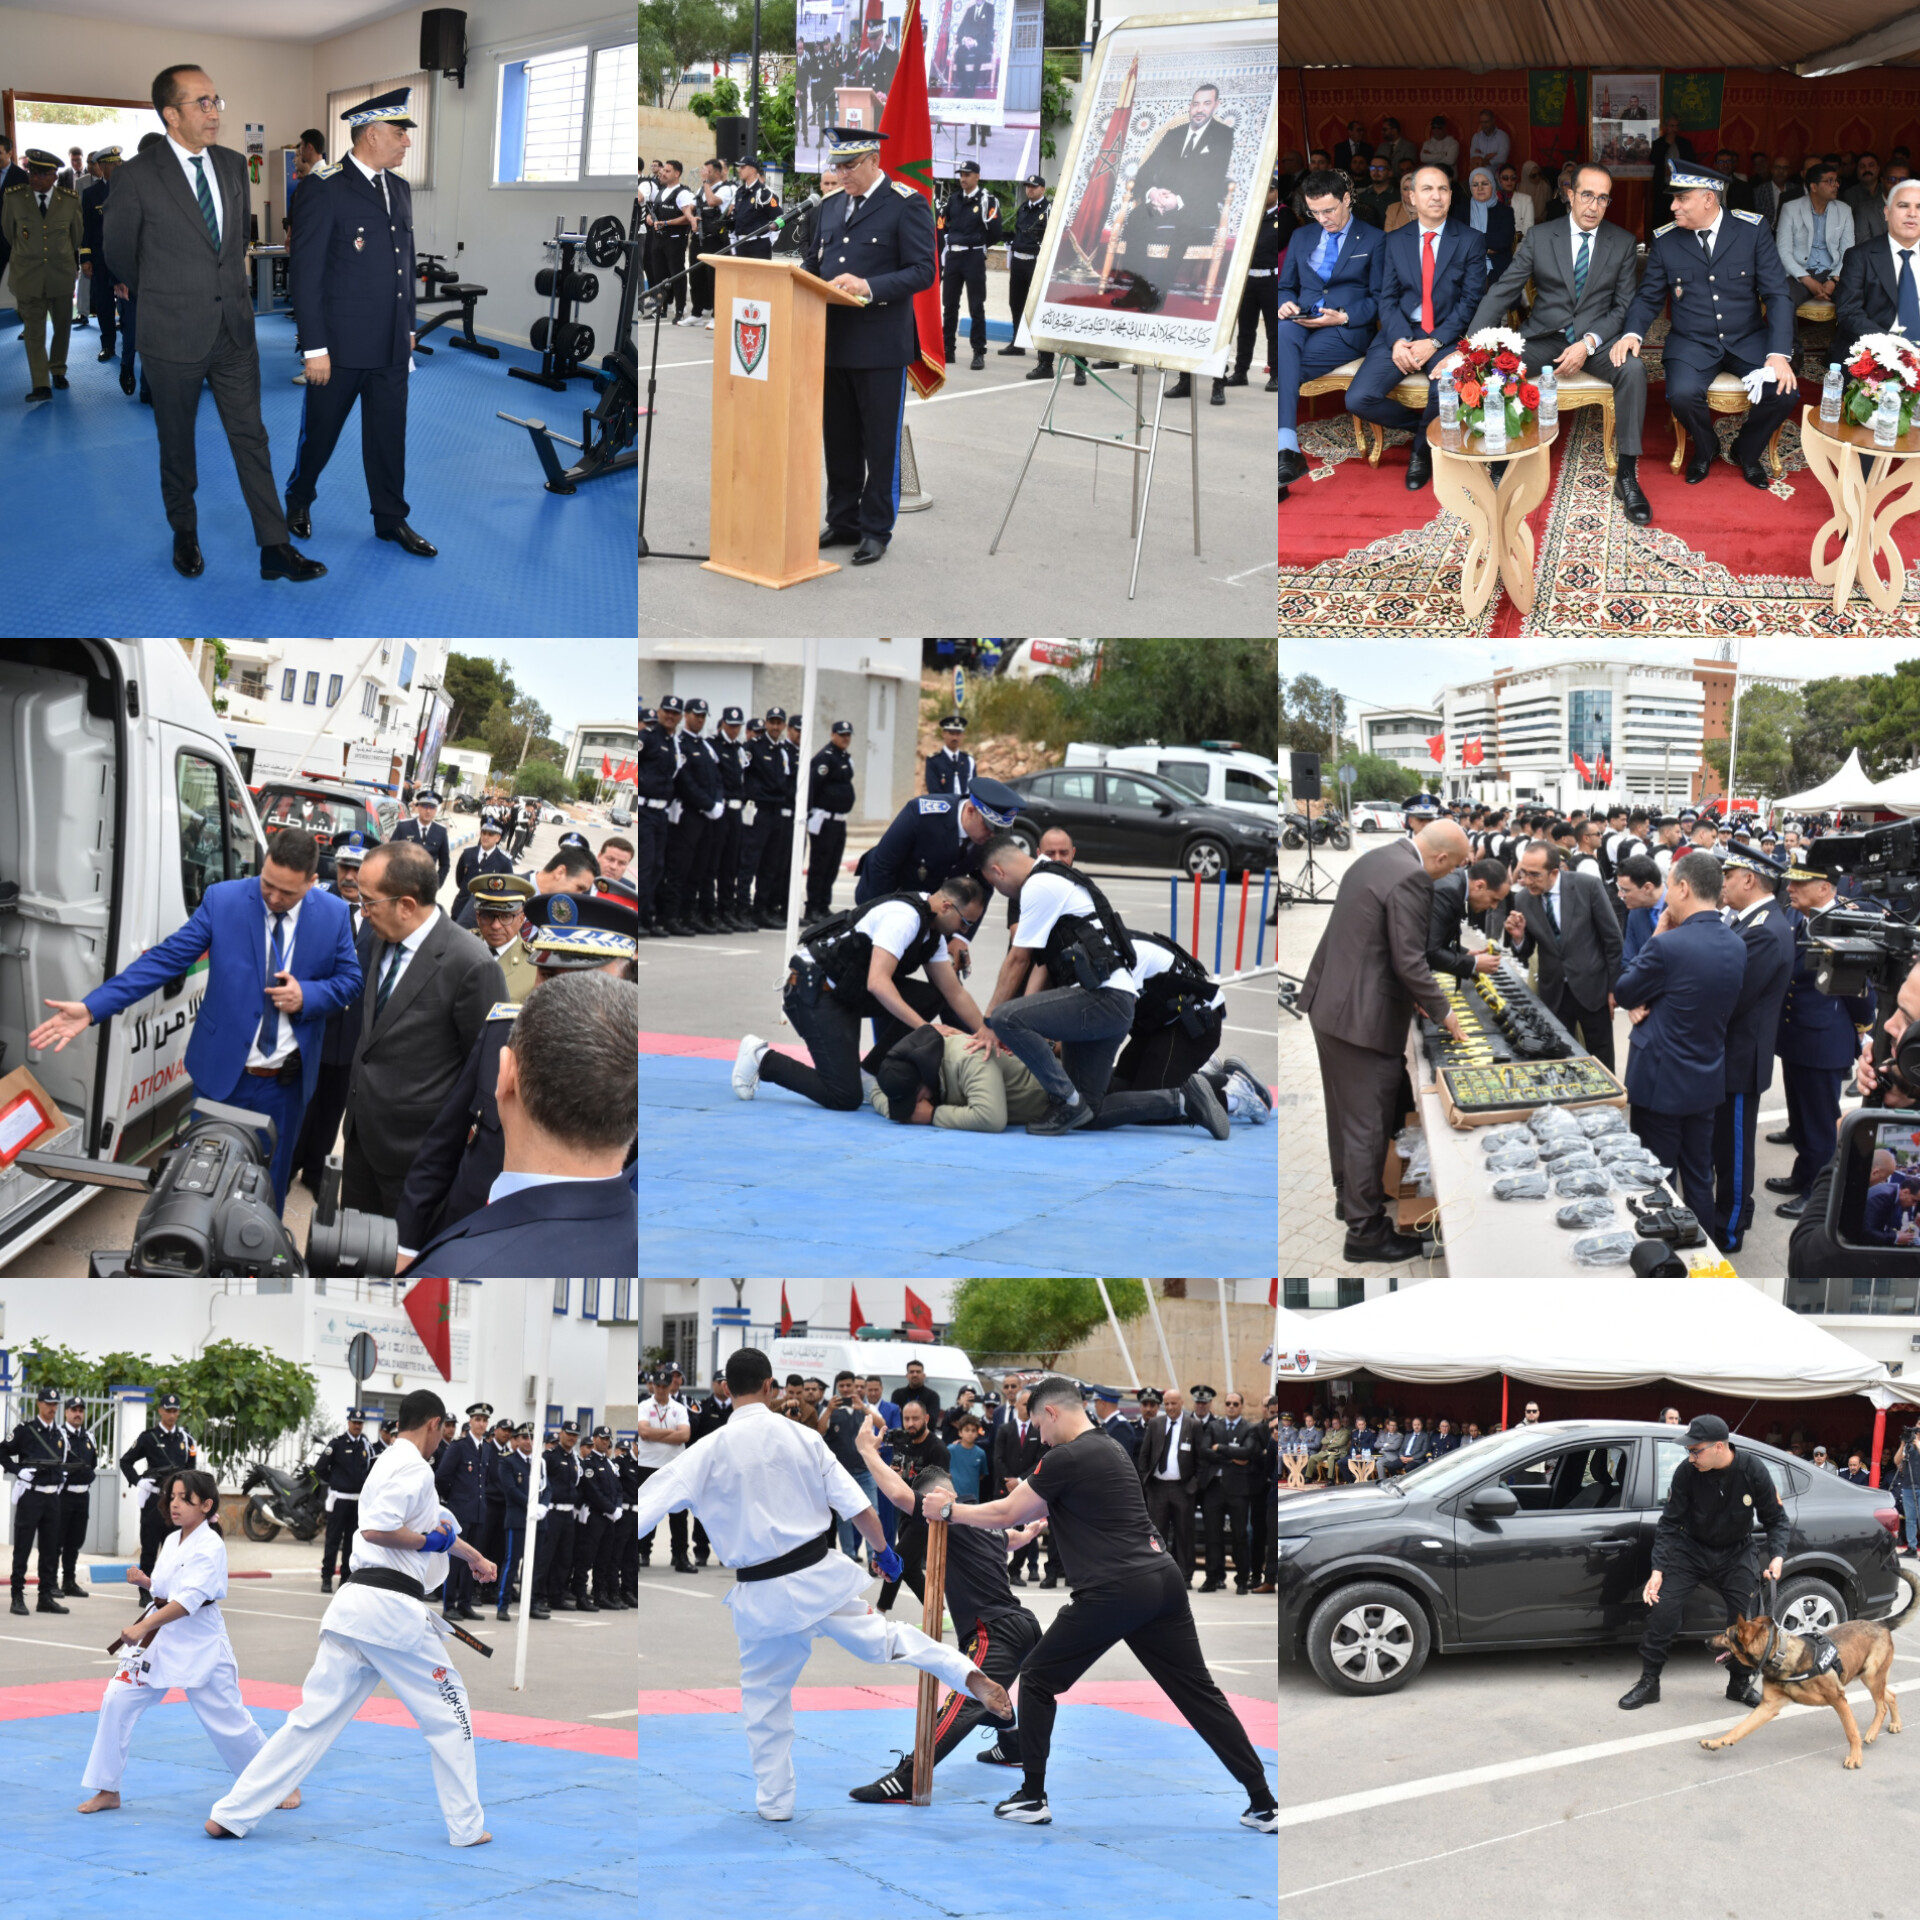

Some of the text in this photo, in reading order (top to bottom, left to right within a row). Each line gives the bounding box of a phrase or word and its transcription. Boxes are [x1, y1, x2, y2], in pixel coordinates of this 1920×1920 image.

[594, 240, 602, 250] 10
[267, 810, 343, 834] الشرطة
[126, 1058, 188, 1110] ATIONA
[1818, 1644, 1837, 1670] POLICE
